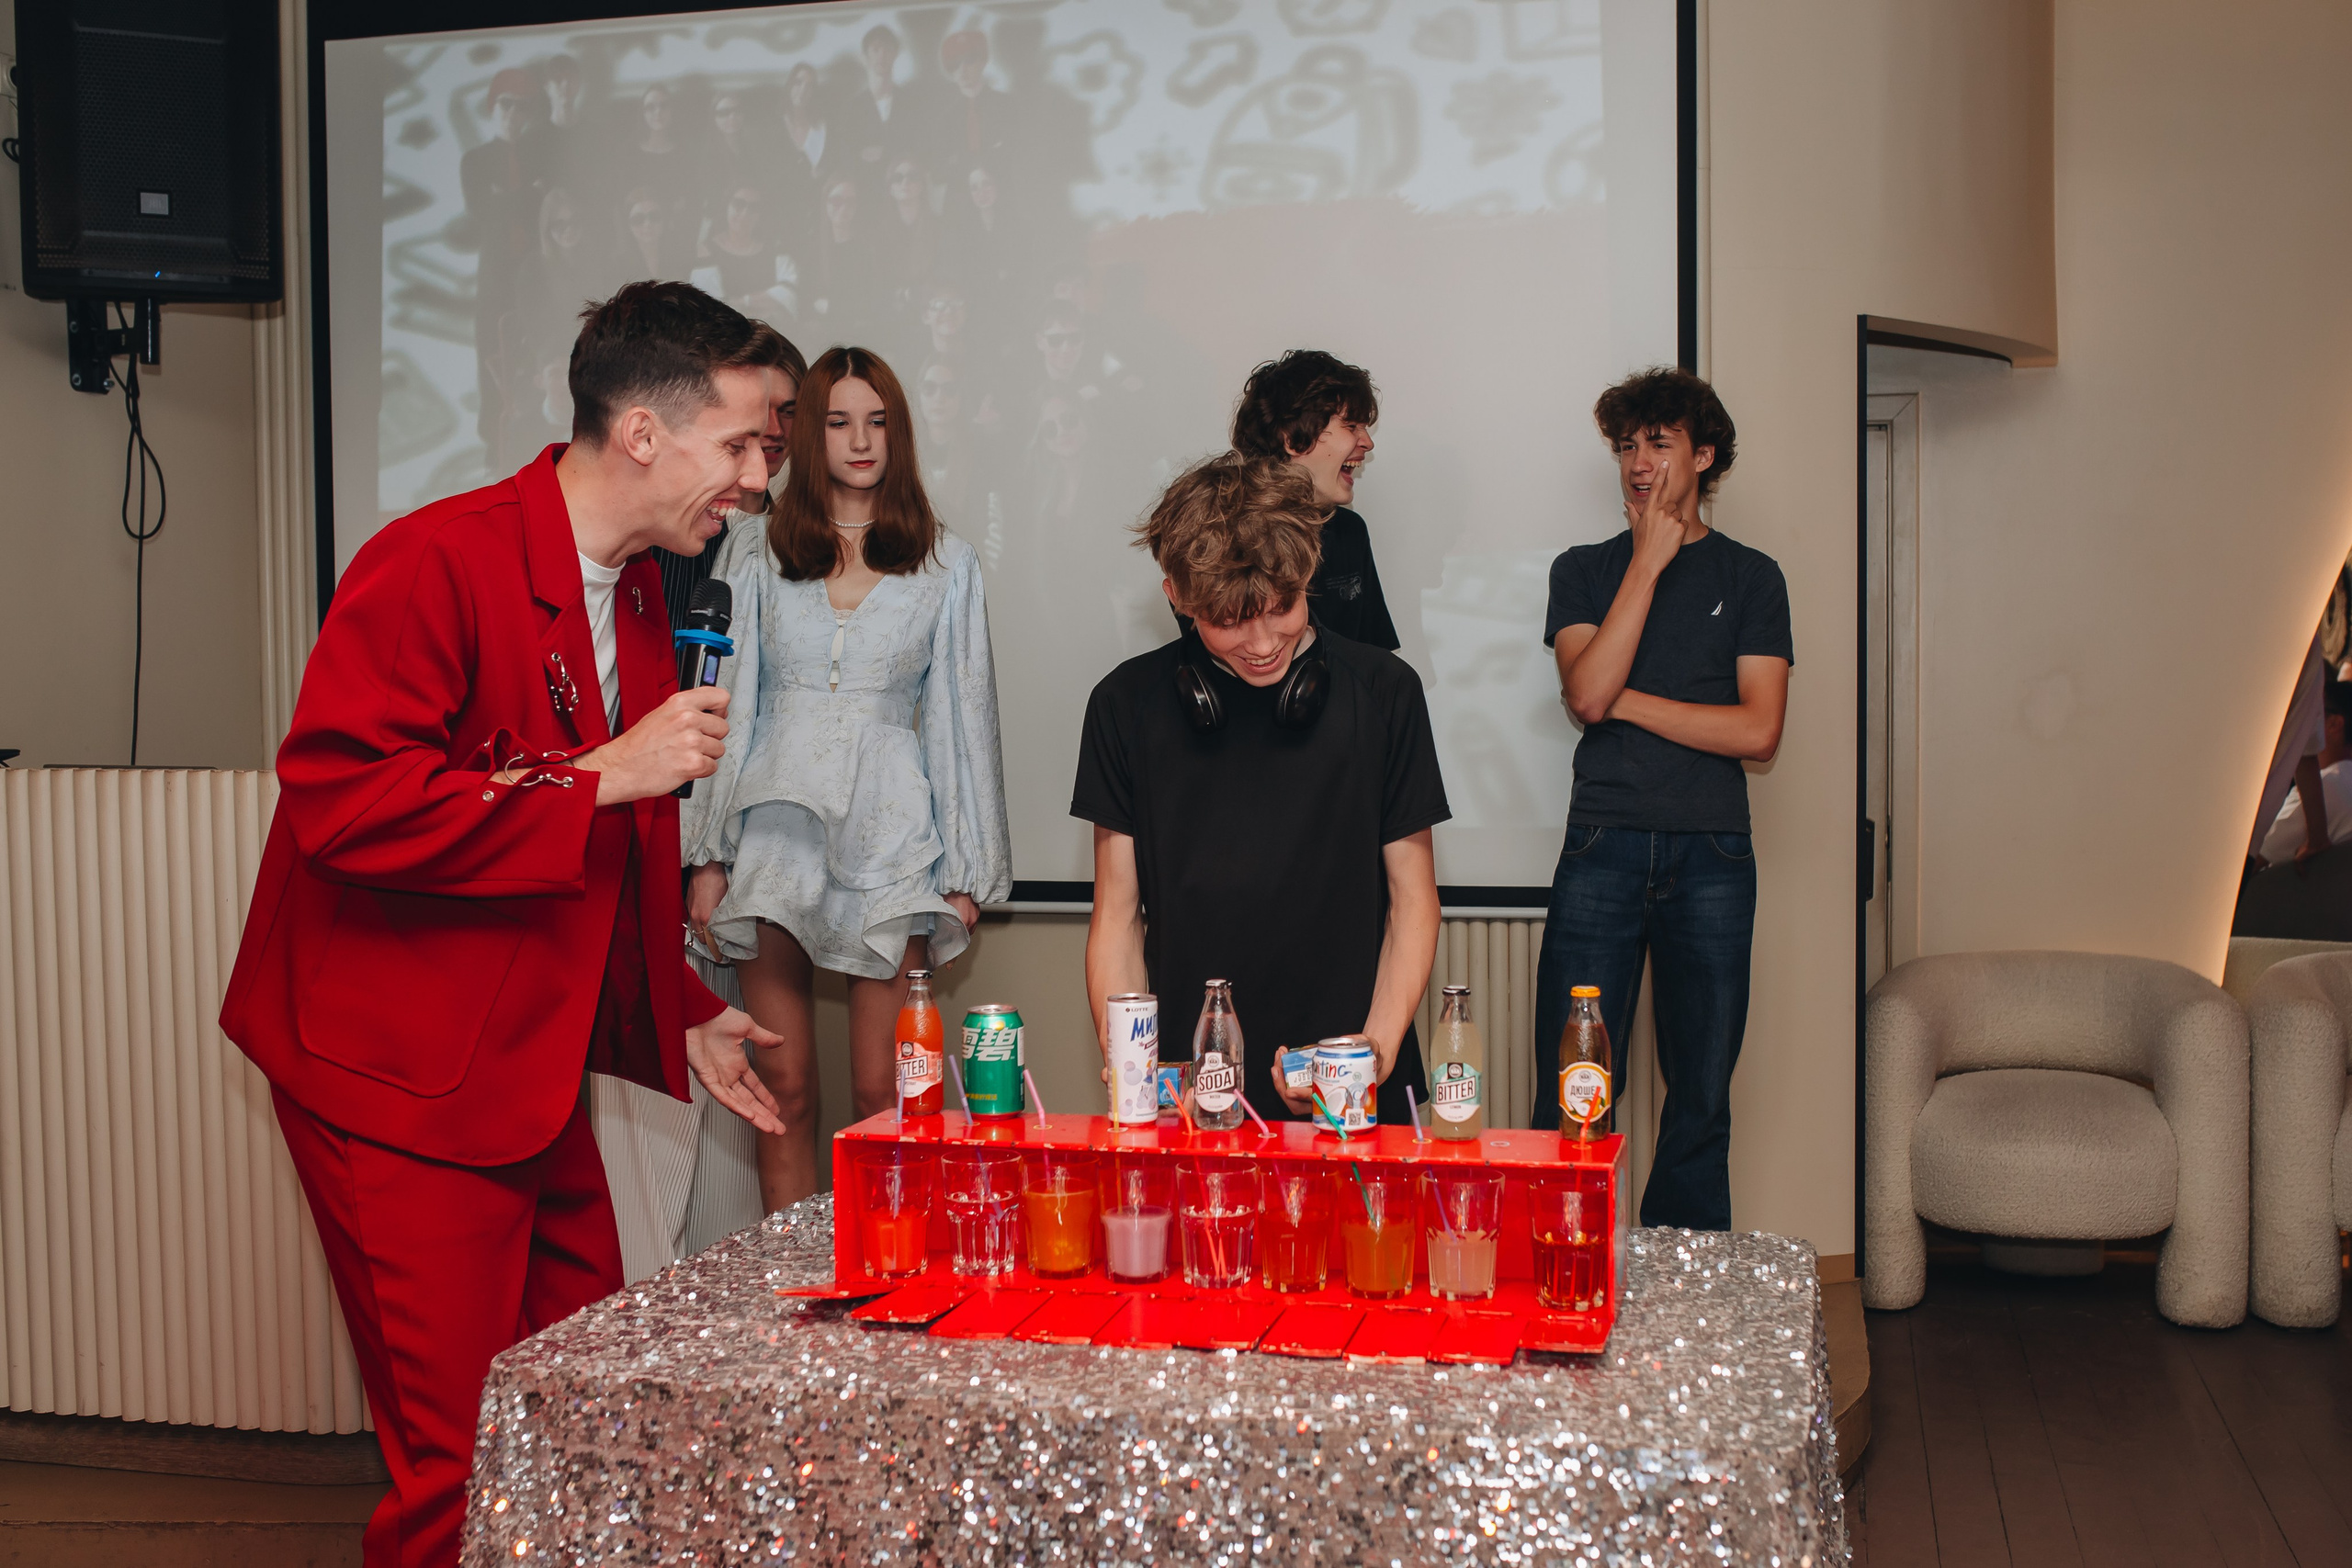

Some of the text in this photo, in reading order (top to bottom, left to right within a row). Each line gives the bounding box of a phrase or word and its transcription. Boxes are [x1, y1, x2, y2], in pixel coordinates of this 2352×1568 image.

[1199, 1071, 1232, 1091] SODA
[1438, 1080, 1474, 1101] BITTER
[1570, 1085, 1598, 1096] ДЮШЕ
